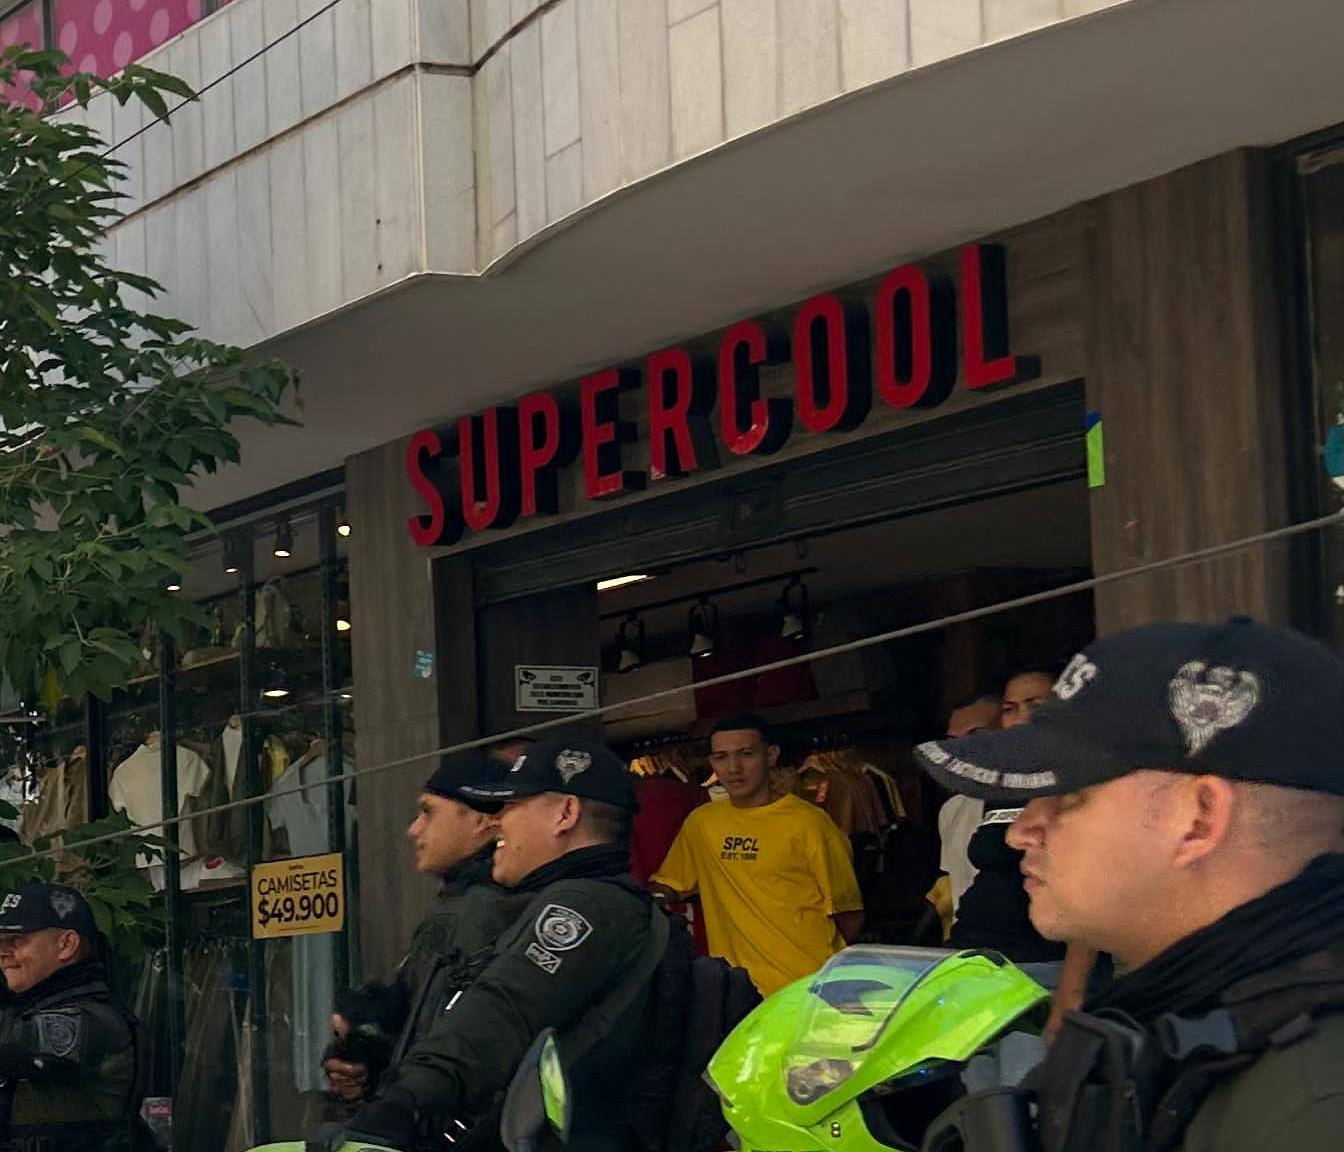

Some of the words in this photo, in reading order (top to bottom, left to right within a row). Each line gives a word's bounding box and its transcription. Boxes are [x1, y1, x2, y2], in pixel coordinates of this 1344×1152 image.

[405, 243, 1017, 547] SUPERCOOL
[723, 836, 759, 852] SPCL
[256, 869, 337, 896] CAMISETAS
[257, 891, 339, 928] $49.900
